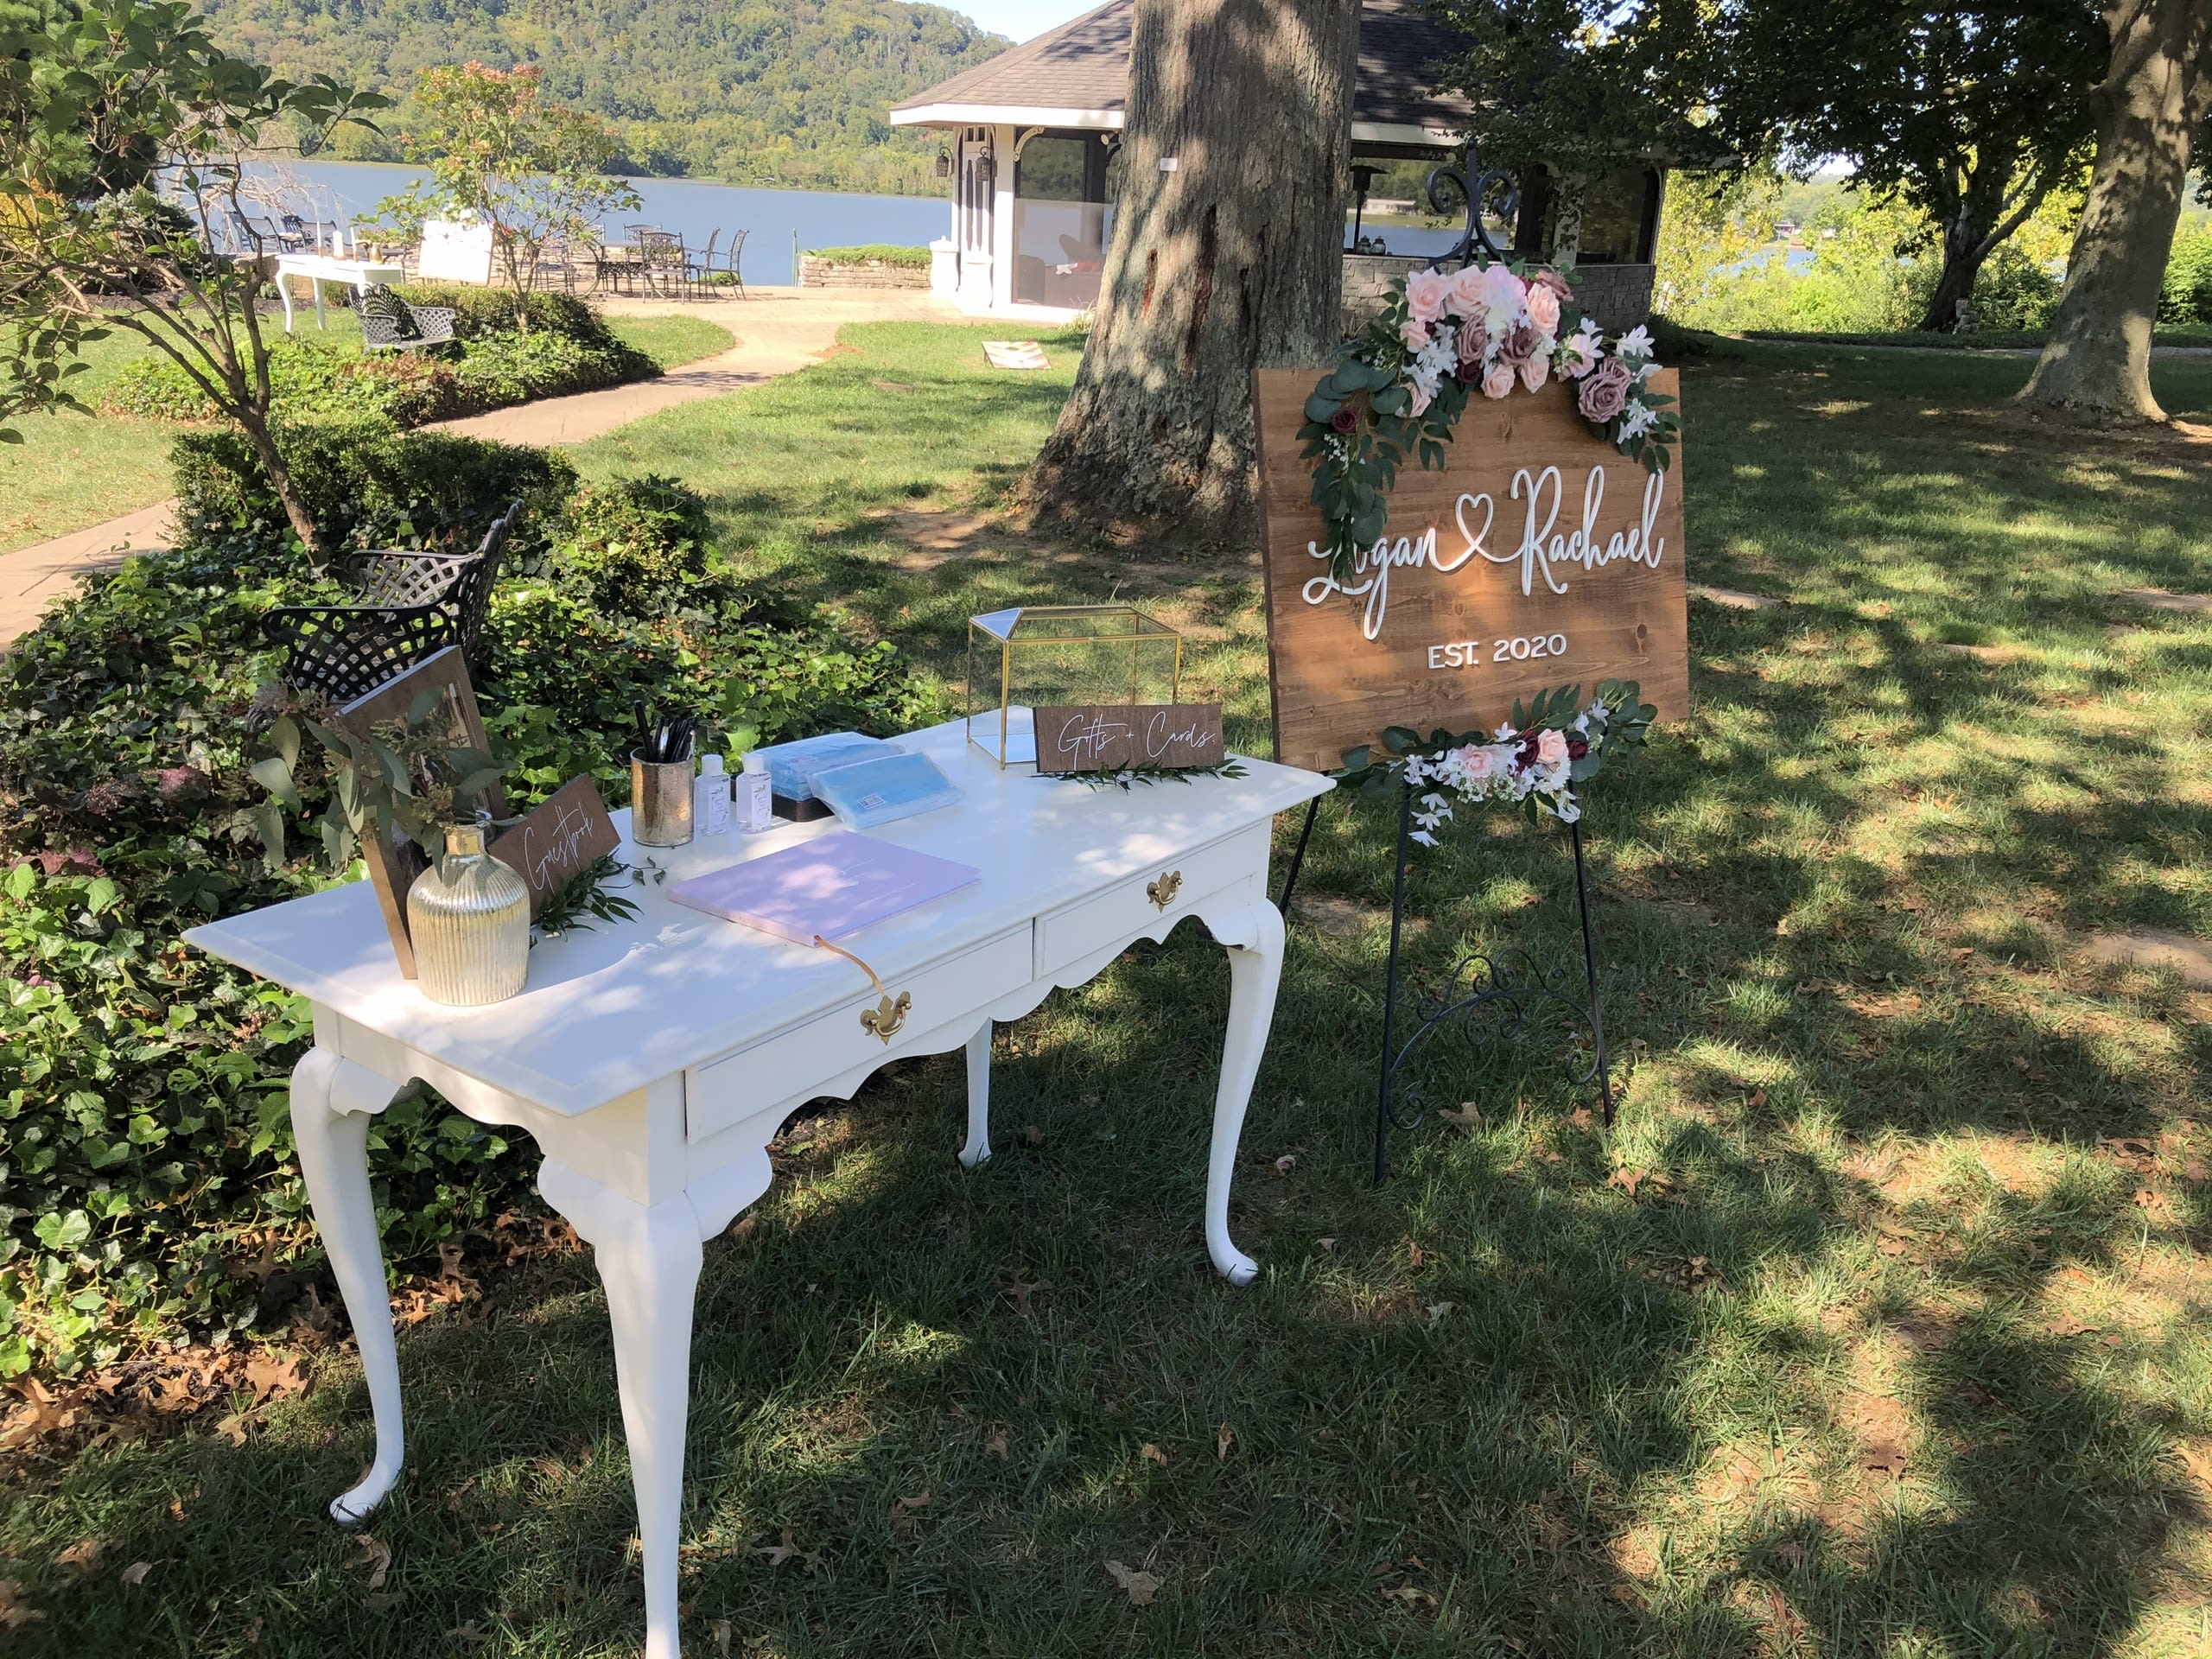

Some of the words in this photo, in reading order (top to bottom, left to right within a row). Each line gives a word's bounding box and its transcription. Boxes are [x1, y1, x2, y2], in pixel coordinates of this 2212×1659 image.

[1510, 465, 1664, 596] Rachael
[1427, 641, 1478, 669] EST.
[1493, 633, 1567, 662] 2020
[1058, 713, 1128, 771] Gifts
[524, 802, 594, 896] Guestbook
